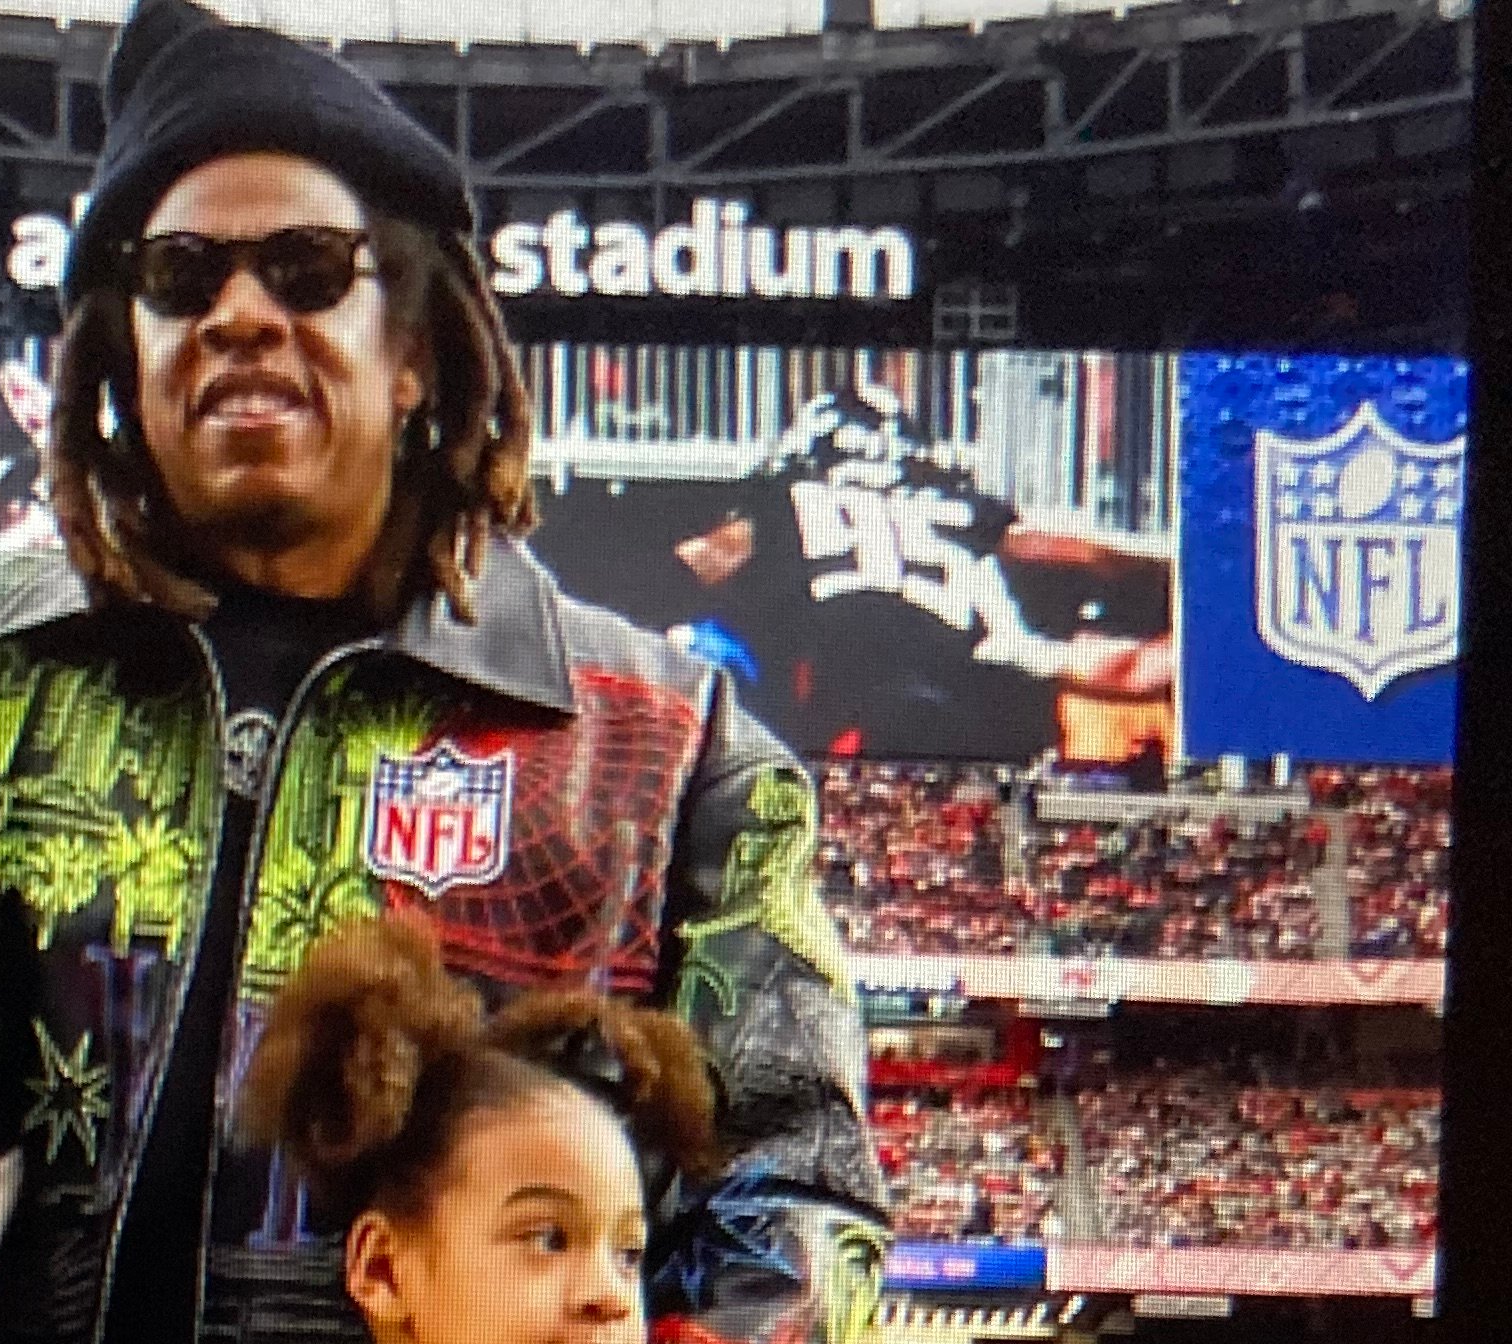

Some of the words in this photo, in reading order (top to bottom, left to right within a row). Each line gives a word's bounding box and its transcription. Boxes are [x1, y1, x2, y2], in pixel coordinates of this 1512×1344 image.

[489, 197, 915, 300] stadium
[790, 481, 976, 632] 95
[1290, 537, 1447, 644] NFL
[377, 805, 493, 874] NFL
